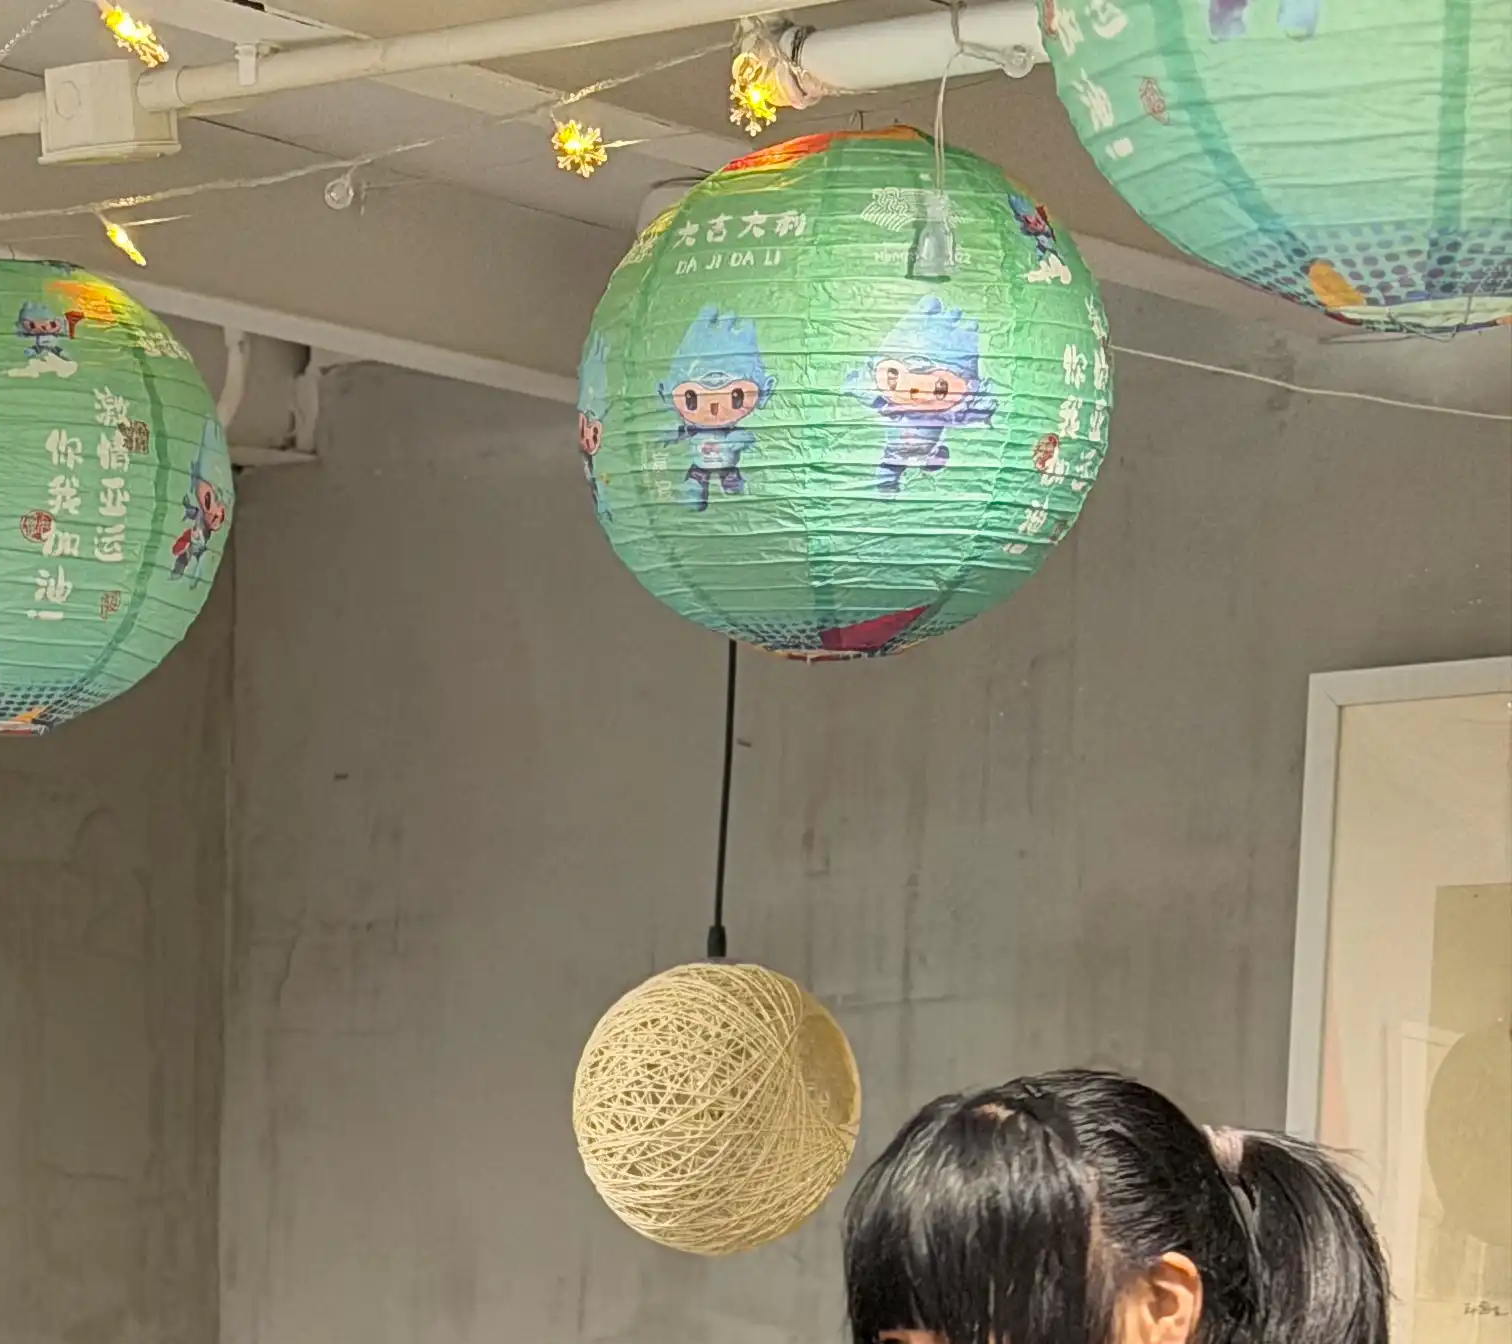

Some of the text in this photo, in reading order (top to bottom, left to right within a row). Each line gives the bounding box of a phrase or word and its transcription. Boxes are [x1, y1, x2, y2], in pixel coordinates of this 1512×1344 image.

[673, 209, 807, 247] 大吉大利
[675, 249, 781, 275] DA JI DA LI
[92, 385, 131, 563] 激情亚运
